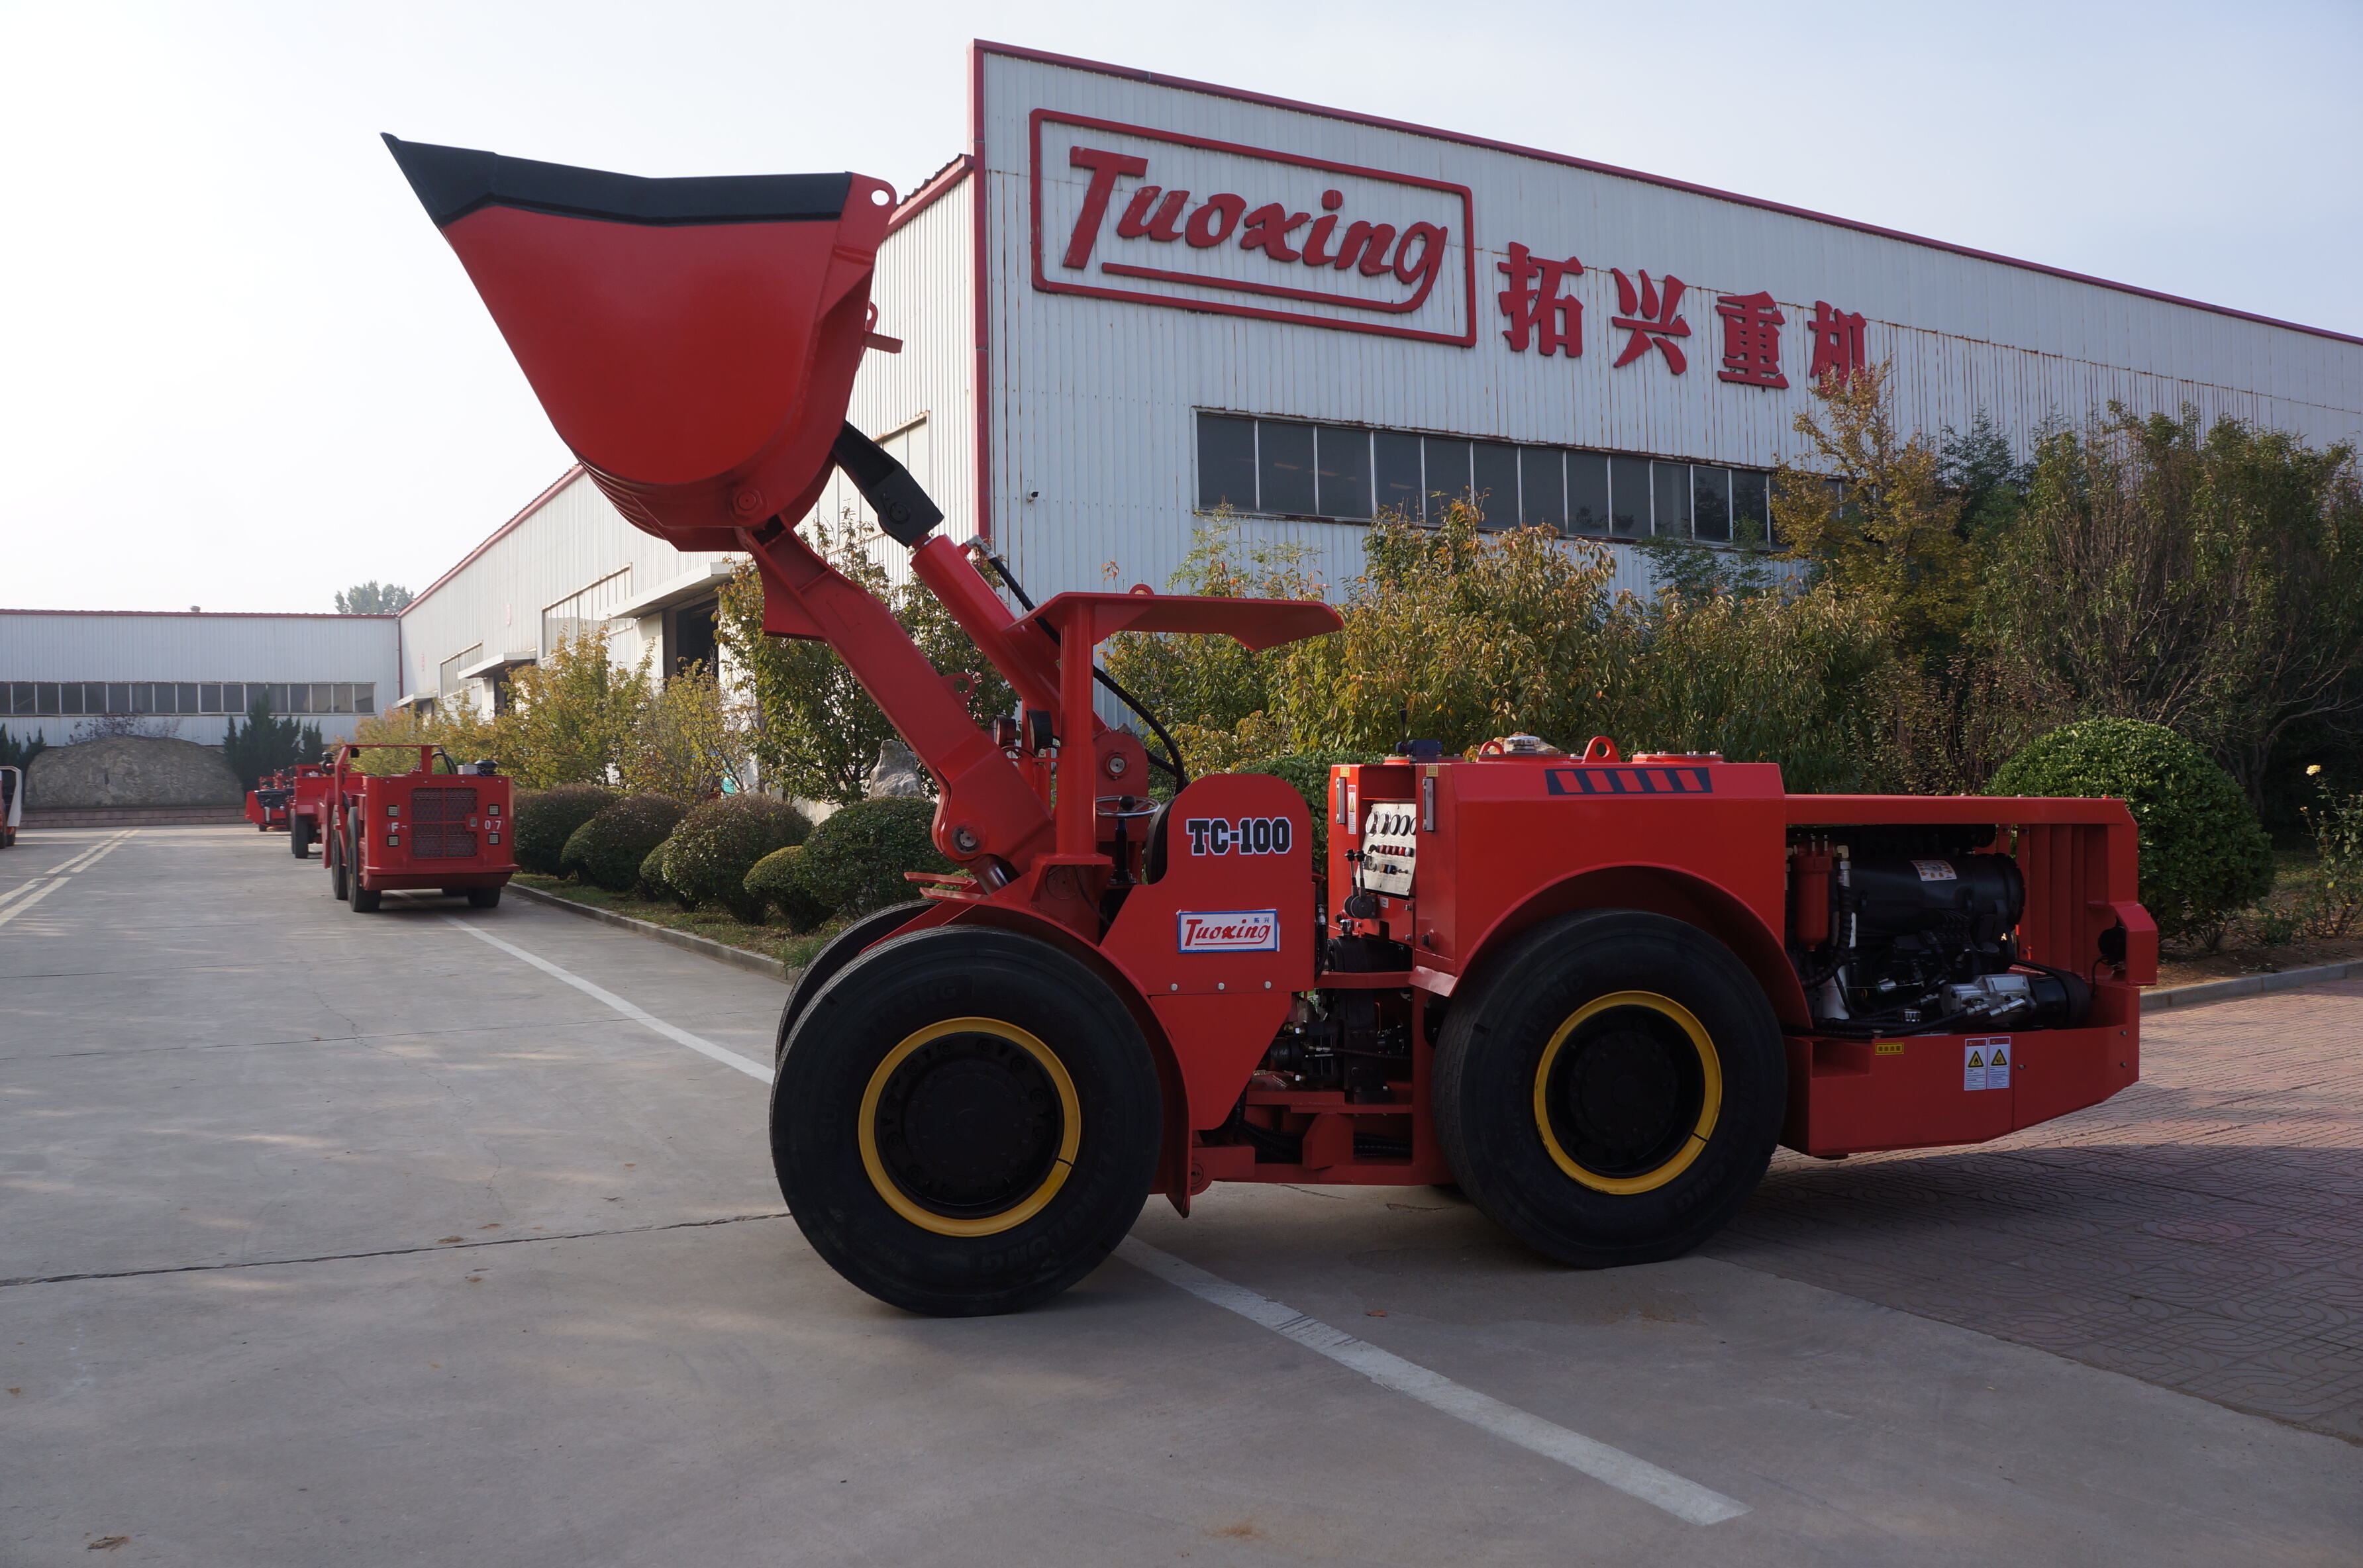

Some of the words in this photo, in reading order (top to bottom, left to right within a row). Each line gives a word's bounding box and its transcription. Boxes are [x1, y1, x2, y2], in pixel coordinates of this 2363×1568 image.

[1062, 145, 1448, 314] Tuoxing
[1497, 241, 1875, 399] 拓兴重机
[1186, 816, 1291, 856] TC-100
[1185, 918, 1272, 946] Tuoxing
